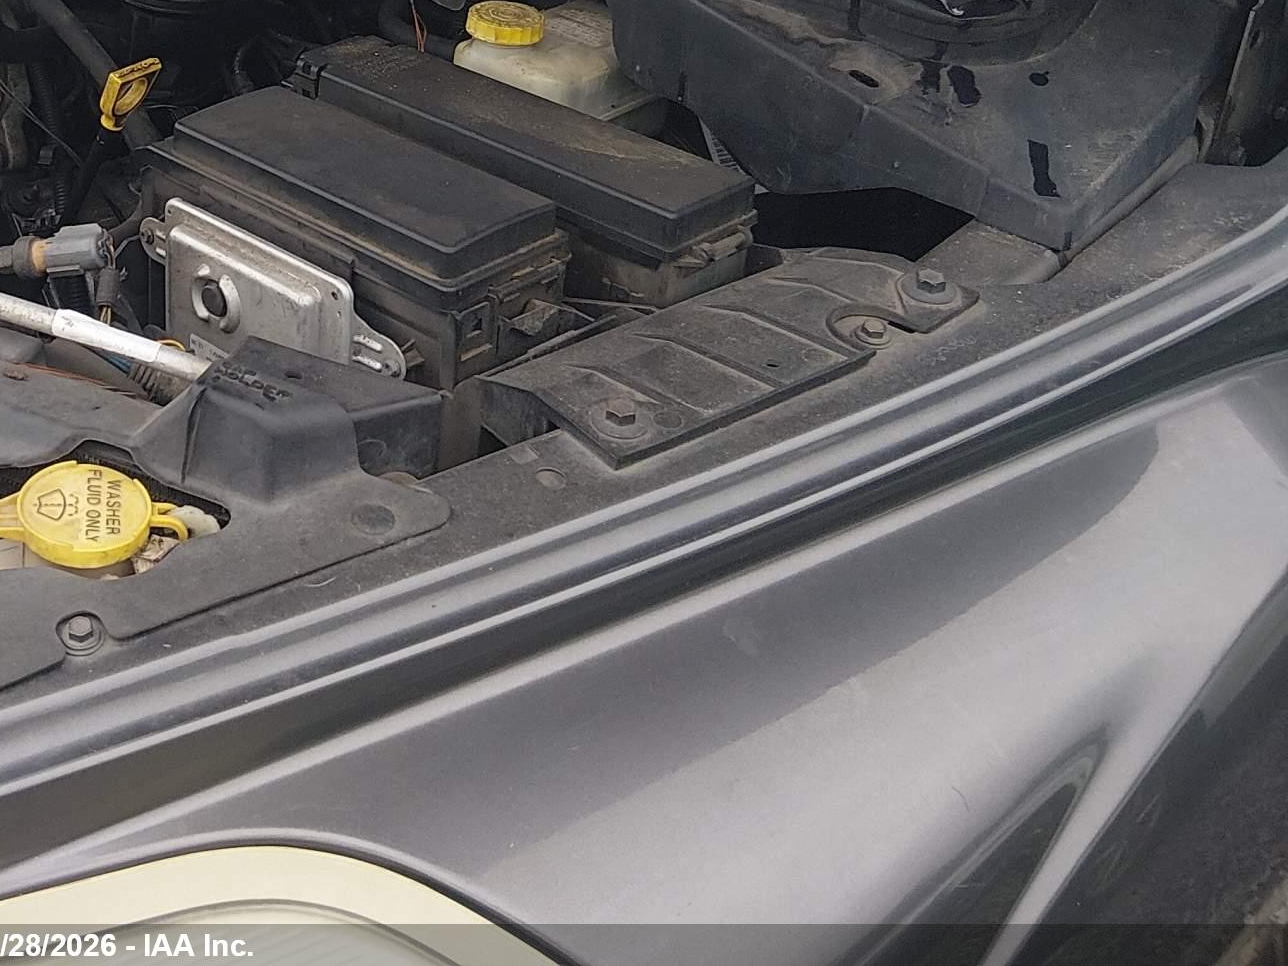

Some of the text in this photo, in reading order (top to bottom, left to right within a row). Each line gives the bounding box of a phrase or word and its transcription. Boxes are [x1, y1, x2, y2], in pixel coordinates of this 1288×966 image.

[85, 469, 102, 542] FLUID ONLY
[106, 480, 121, 535] WASHER
